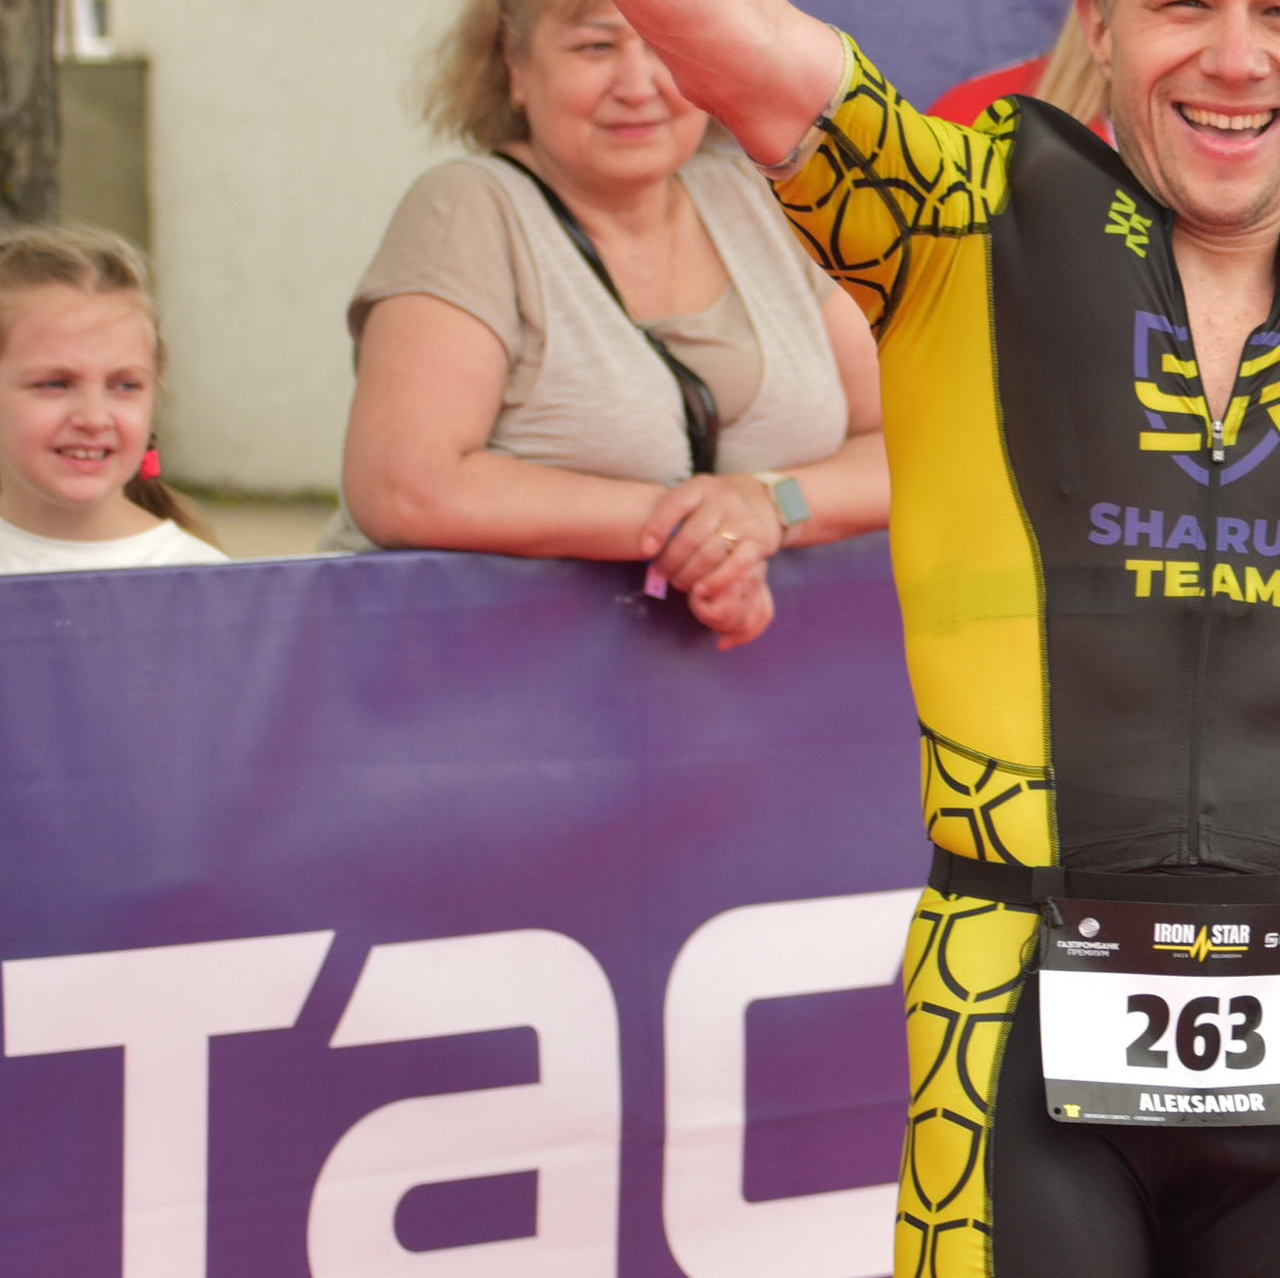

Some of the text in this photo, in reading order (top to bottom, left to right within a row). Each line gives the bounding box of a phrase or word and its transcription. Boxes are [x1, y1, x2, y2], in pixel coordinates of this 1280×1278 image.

[1153, 922, 1250, 944] IRON STAR
[1126, 993, 1267, 1072] 263
[1139, 1093, 1266, 1114] ALEKSANDR
